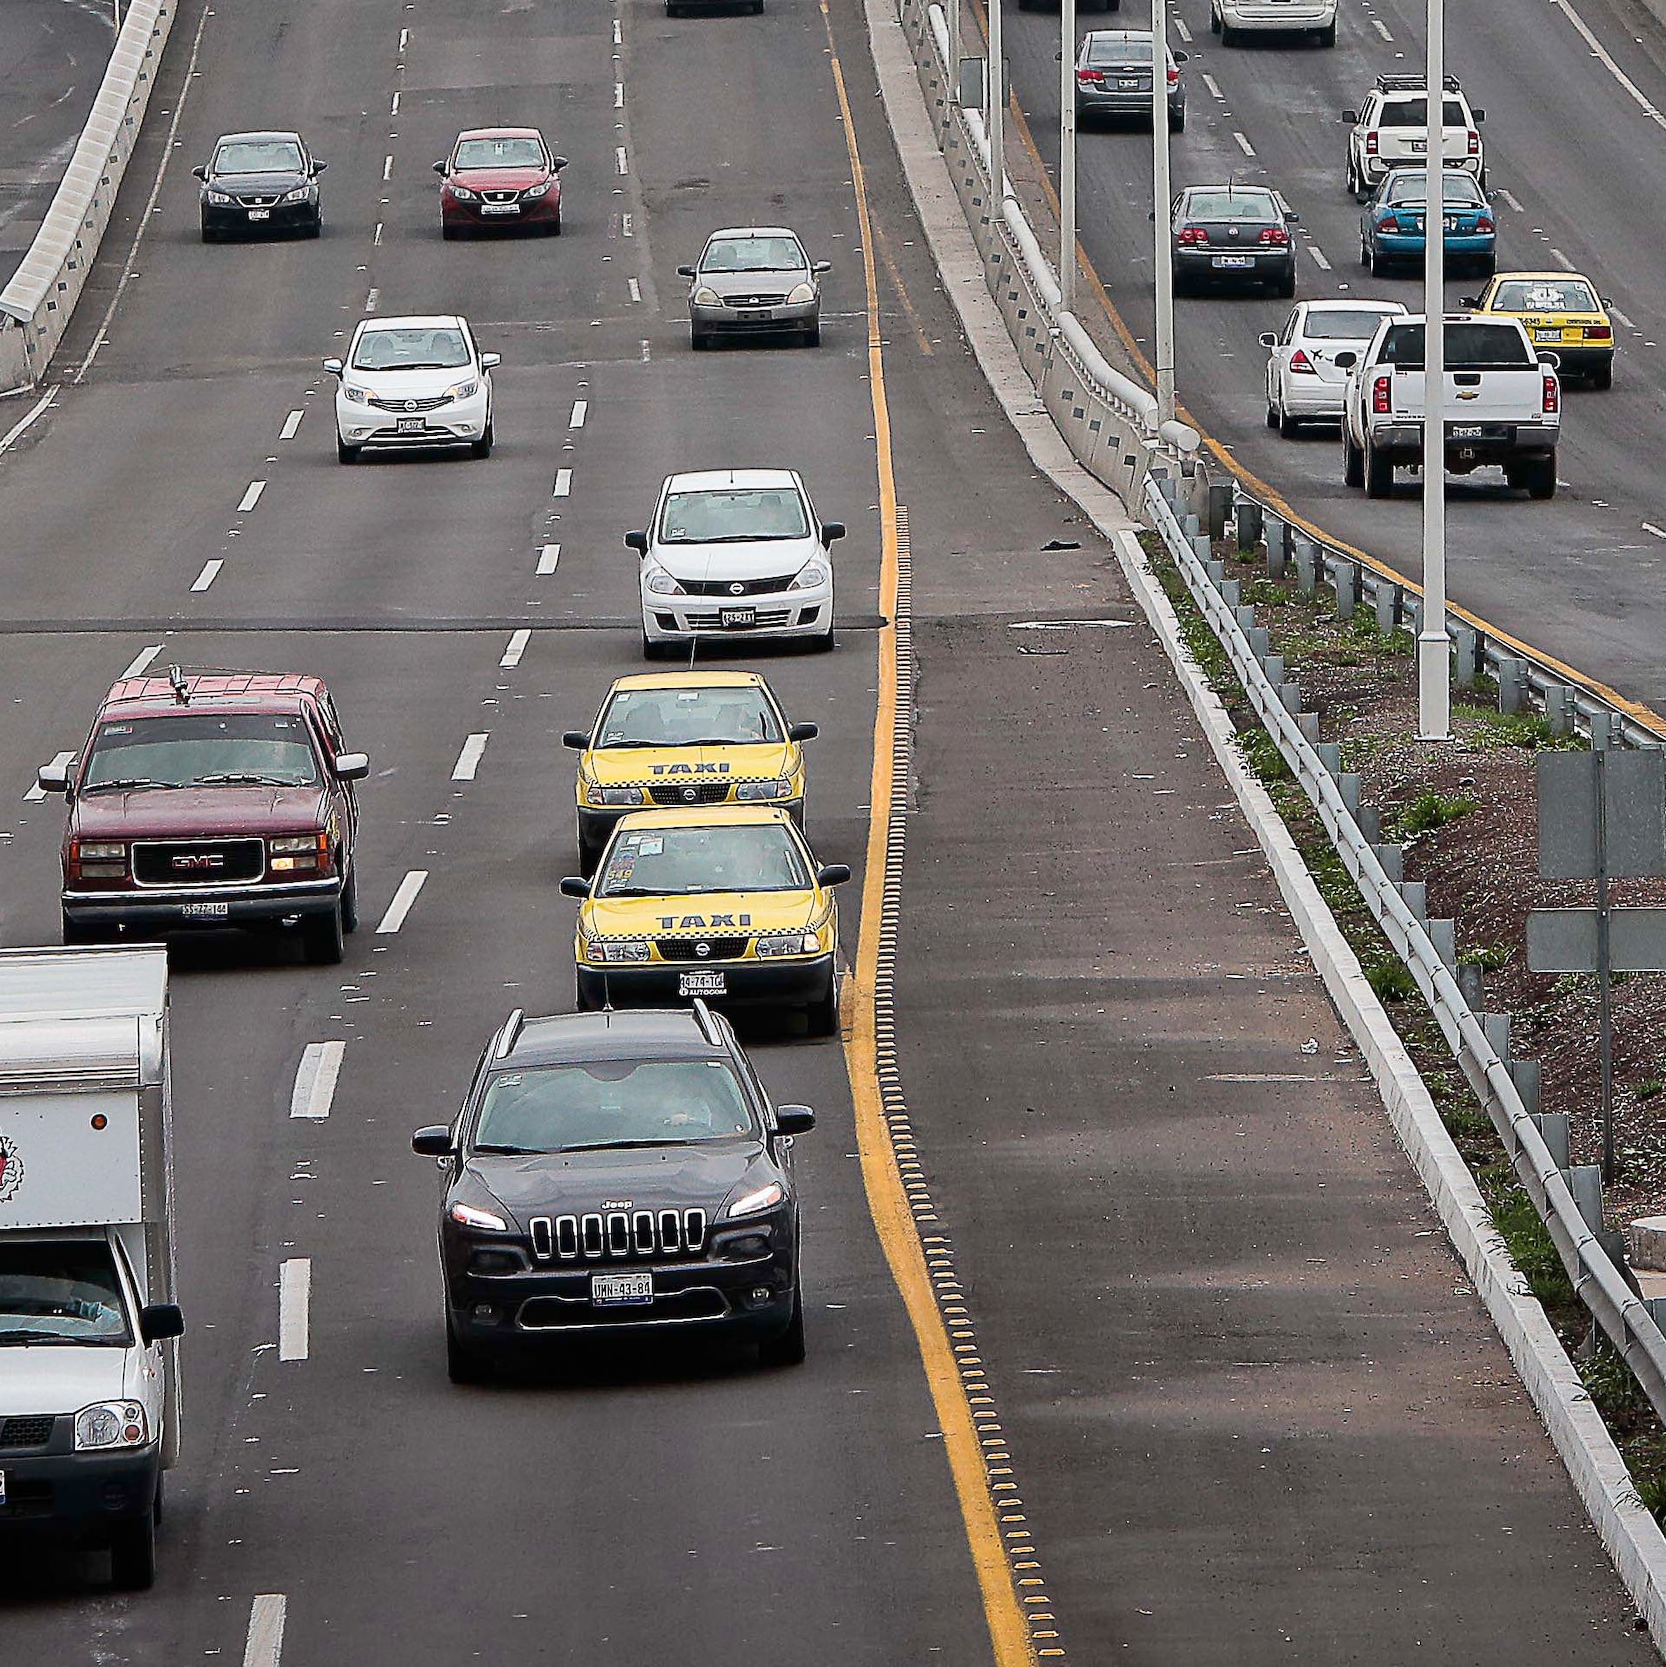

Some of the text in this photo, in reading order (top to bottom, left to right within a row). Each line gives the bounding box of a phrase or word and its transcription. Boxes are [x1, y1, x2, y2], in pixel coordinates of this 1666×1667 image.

[647, 763, 731, 775] TAXI
[173, 855, 224, 868] GMC
[656, 913, 754, 930] TAXI
[601, 1200, 633, 1210] Jeep
